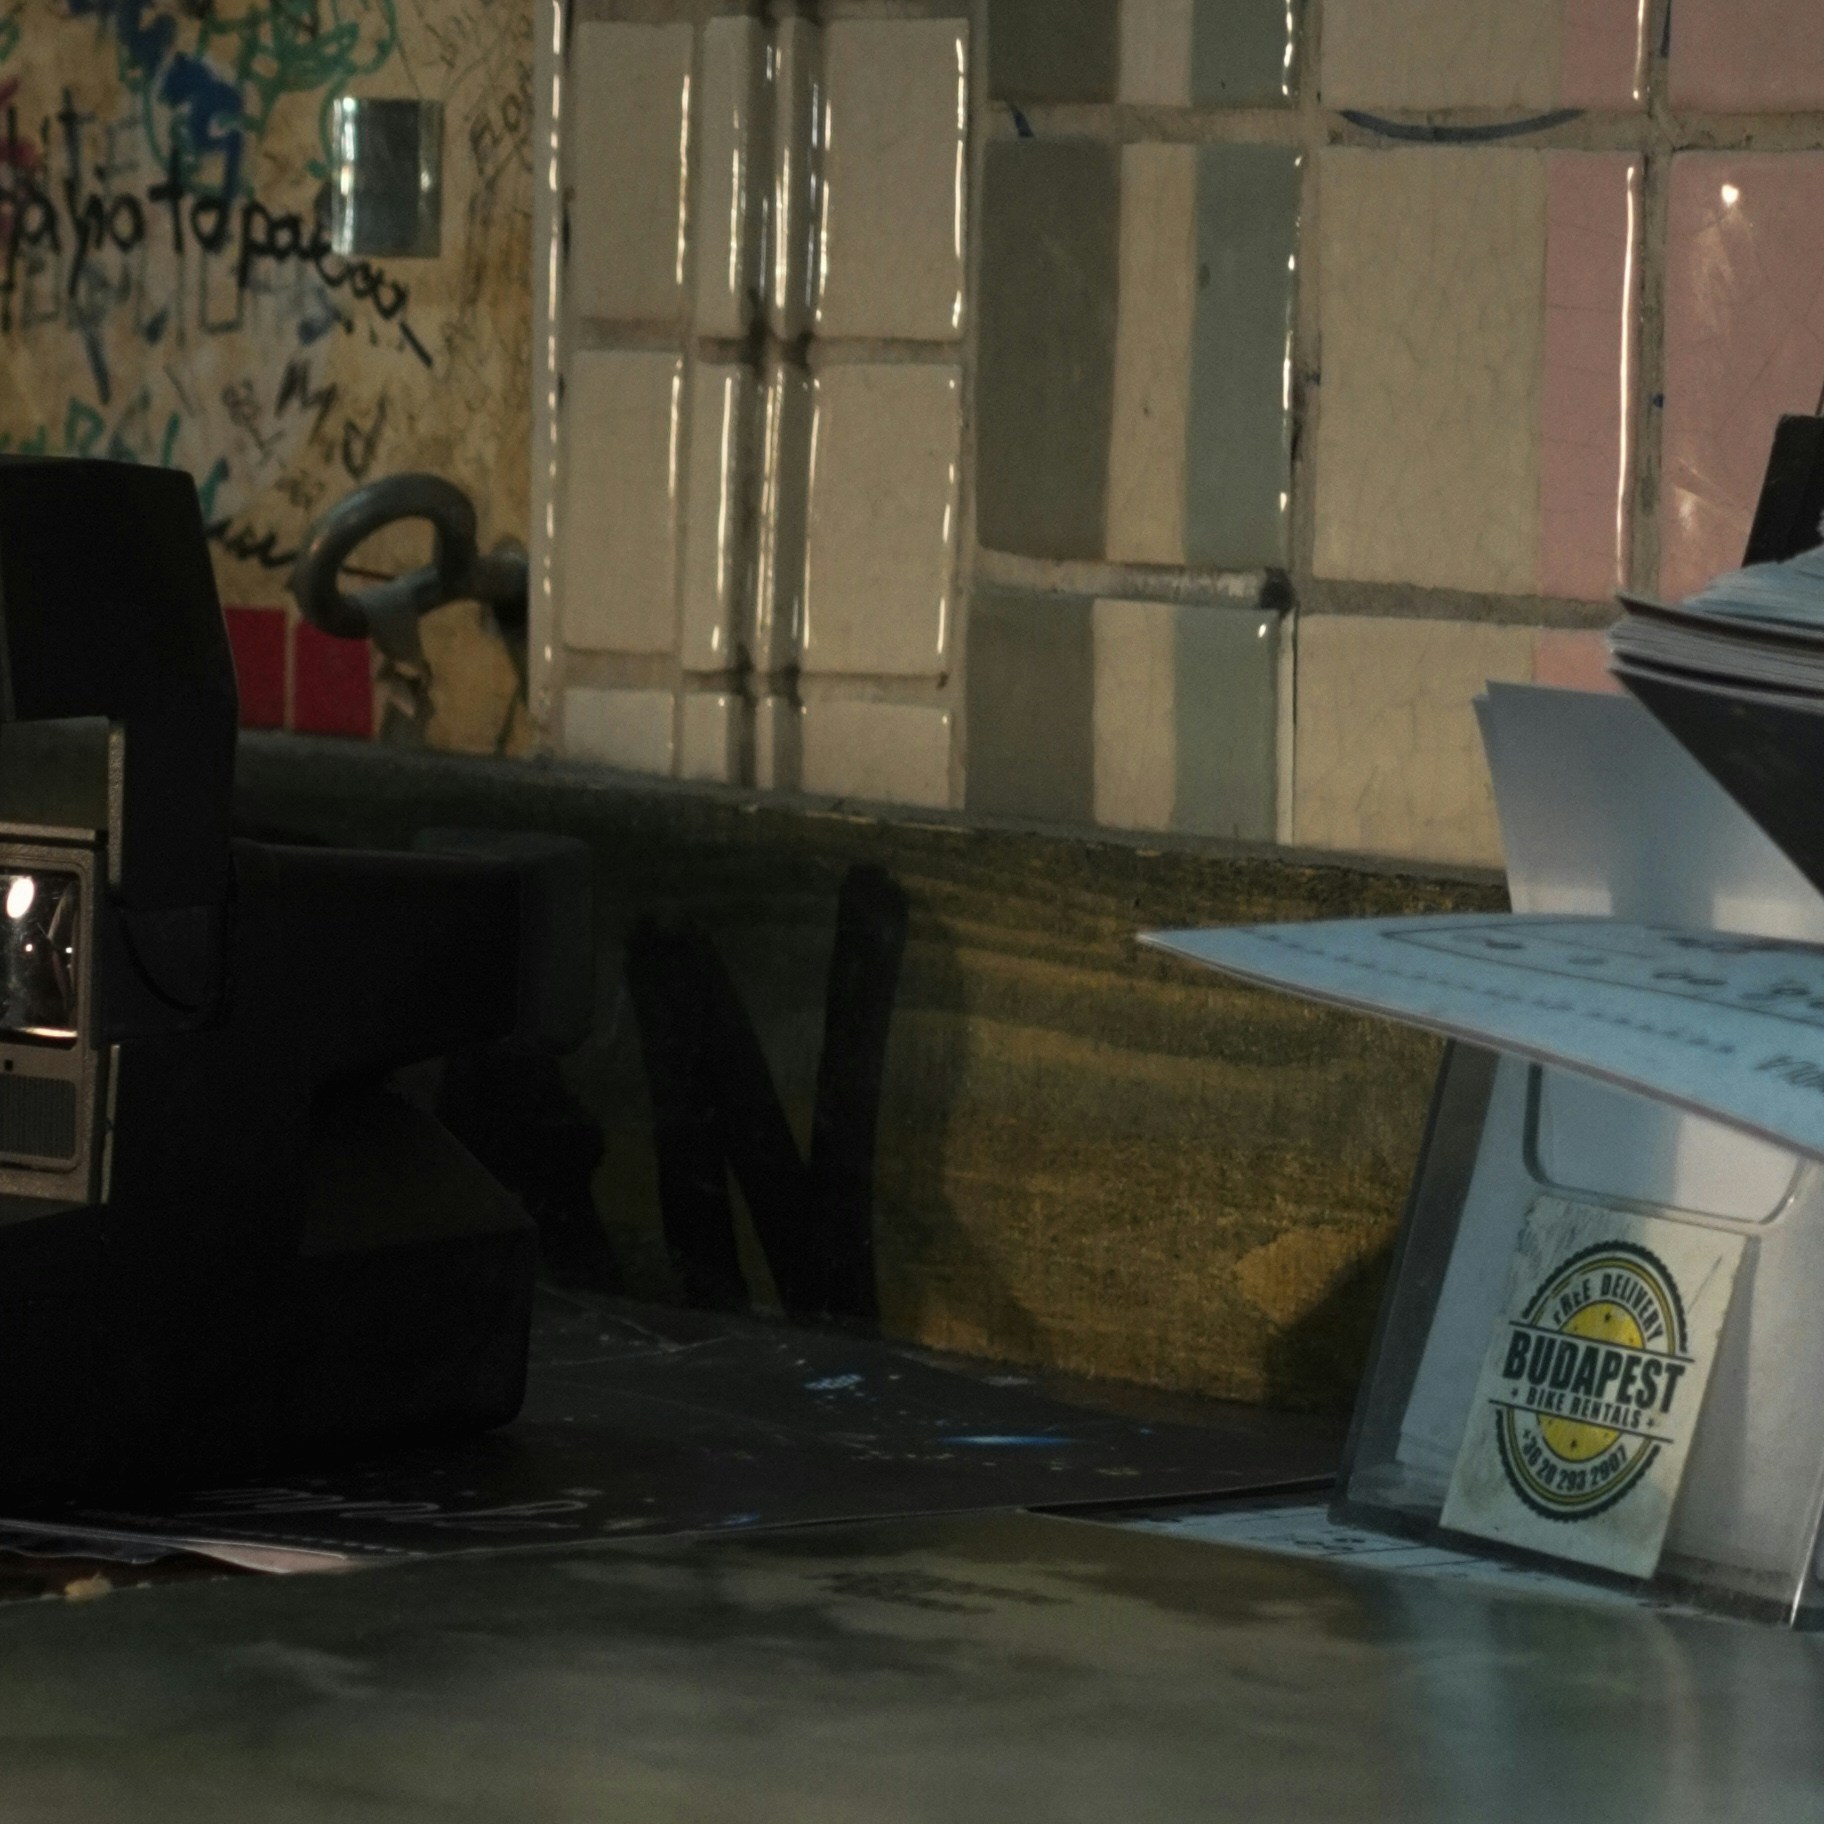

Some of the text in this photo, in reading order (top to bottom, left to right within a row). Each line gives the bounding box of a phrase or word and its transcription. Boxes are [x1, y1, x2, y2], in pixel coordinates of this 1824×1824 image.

[1600, 1274, 1664, 1344] DELIVERY
[1502, 1329, 1686, 1414] BUDAPEST
[1526, 1386, 1643, 1431] BIKE RENTALS
